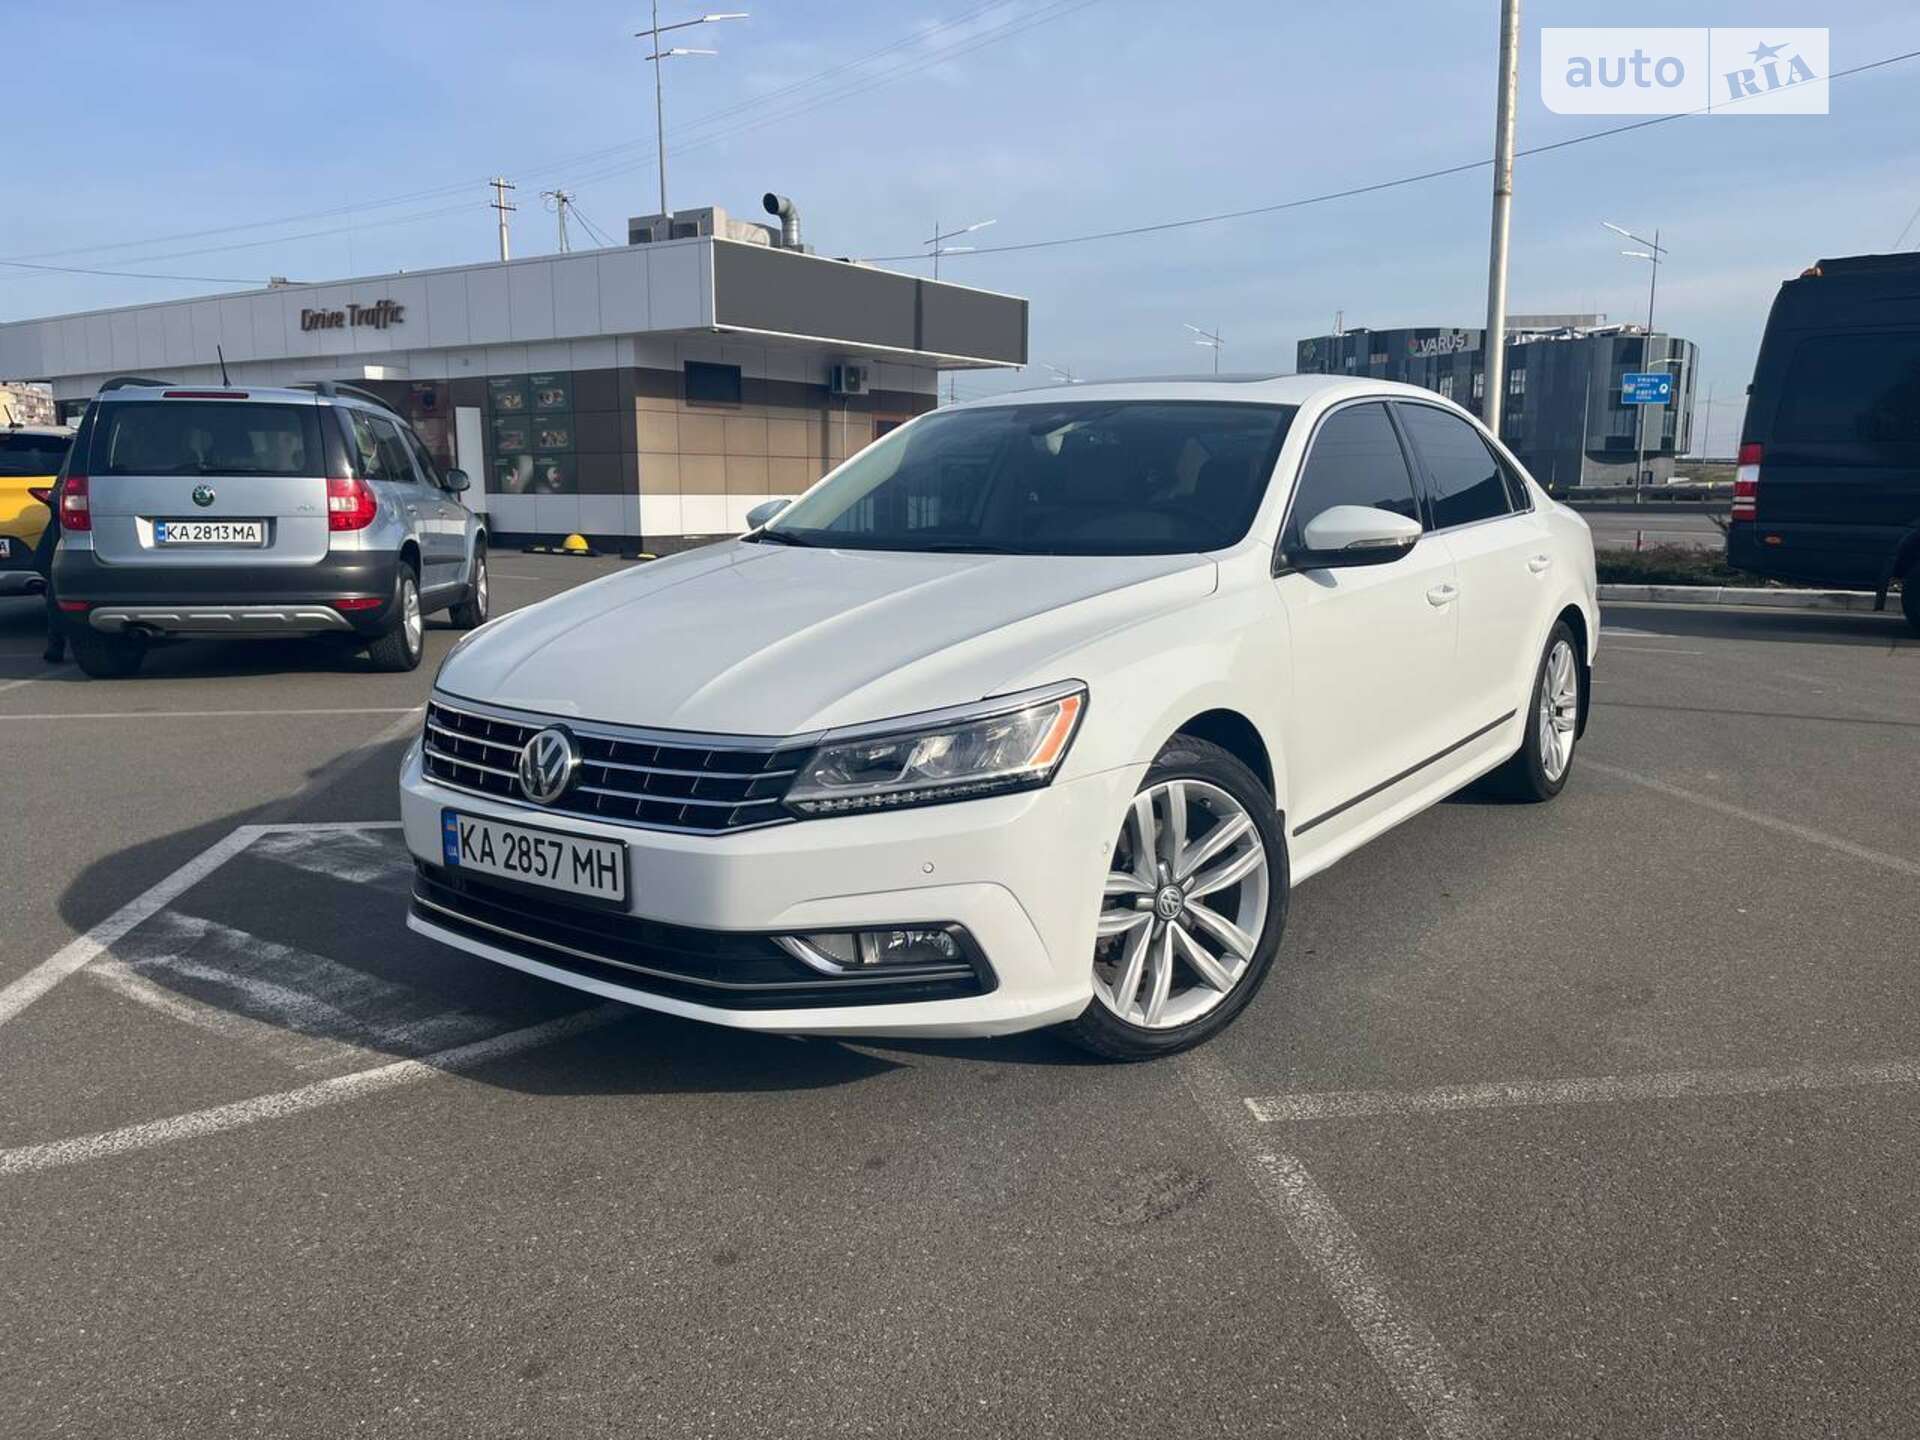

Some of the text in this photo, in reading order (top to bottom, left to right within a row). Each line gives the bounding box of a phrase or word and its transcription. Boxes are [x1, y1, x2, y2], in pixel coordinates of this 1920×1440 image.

[301, 299, 404, 331] Drive Traffic
[1420, 333, 1465, 353] VARUS
[167, 526, 189, 540] KA
[194, 525, 230, 540] 2813
[233, 526, 256, 540] MA
[460, 822, 618, 891] KA 2857 MH
